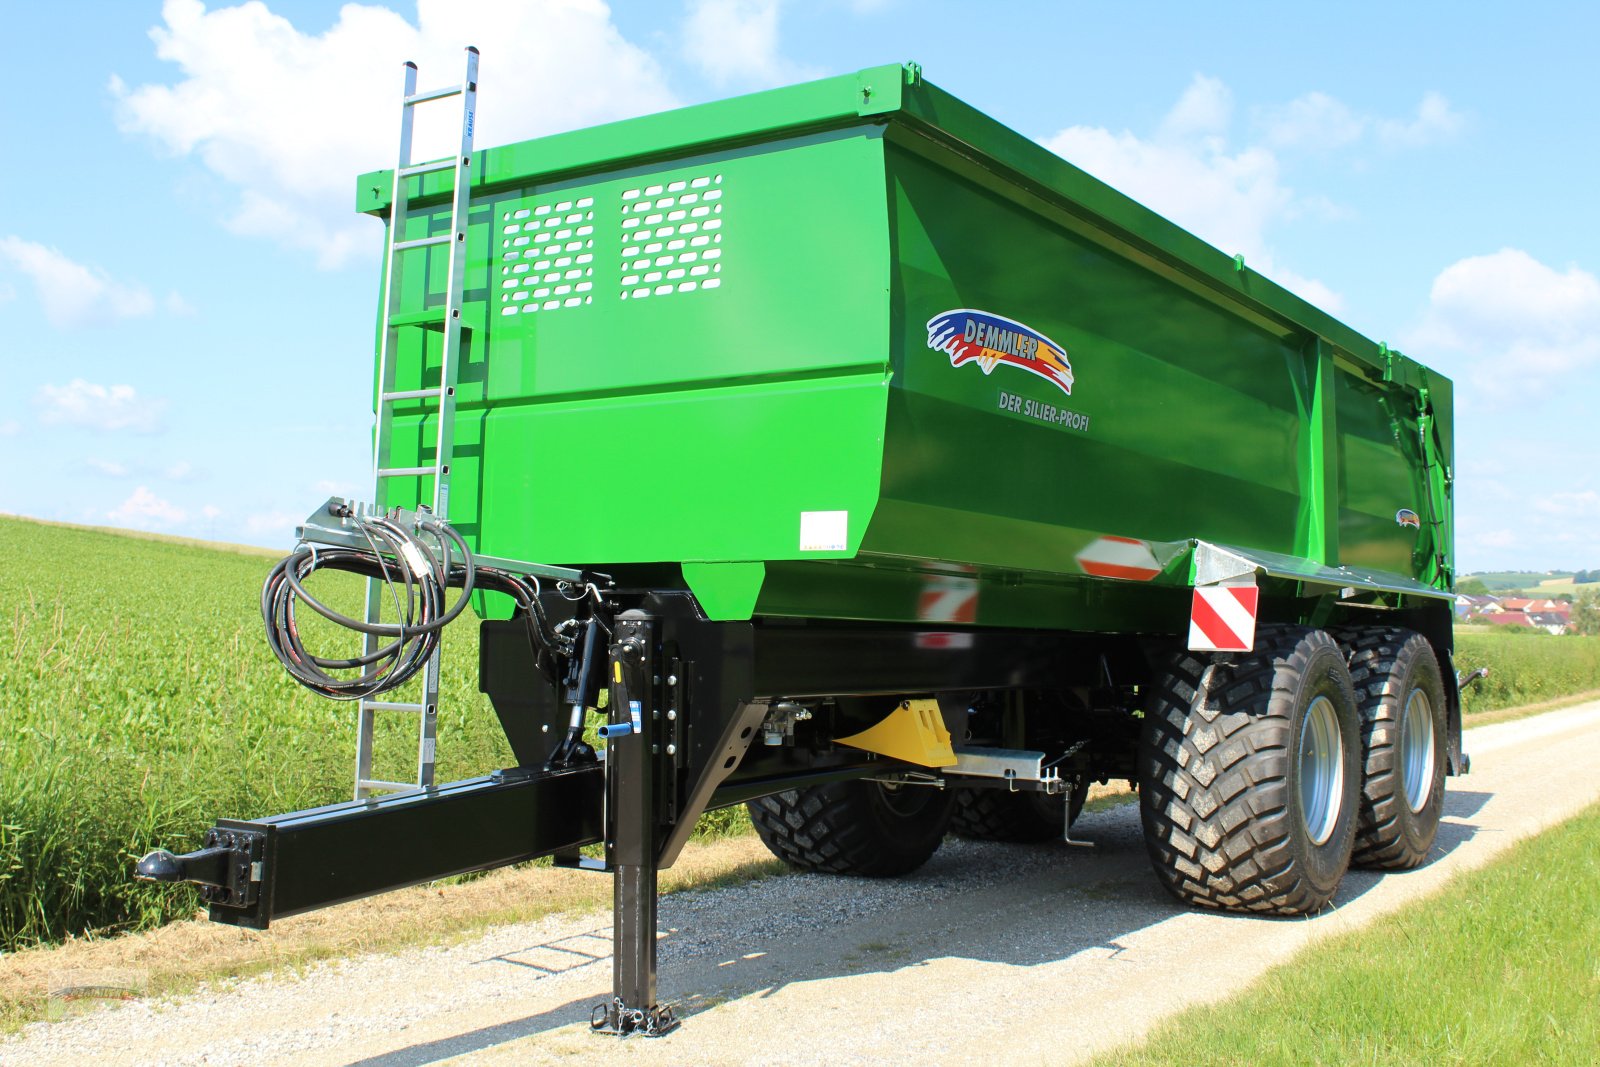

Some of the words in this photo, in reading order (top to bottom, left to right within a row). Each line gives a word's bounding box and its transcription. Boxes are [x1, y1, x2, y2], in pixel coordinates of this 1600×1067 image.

[963, 318, 1038, 361] DEMMLER
[999, 391, 1021, 413] DER
[1024, 399, 1089, 431] SILIER-PROFI
